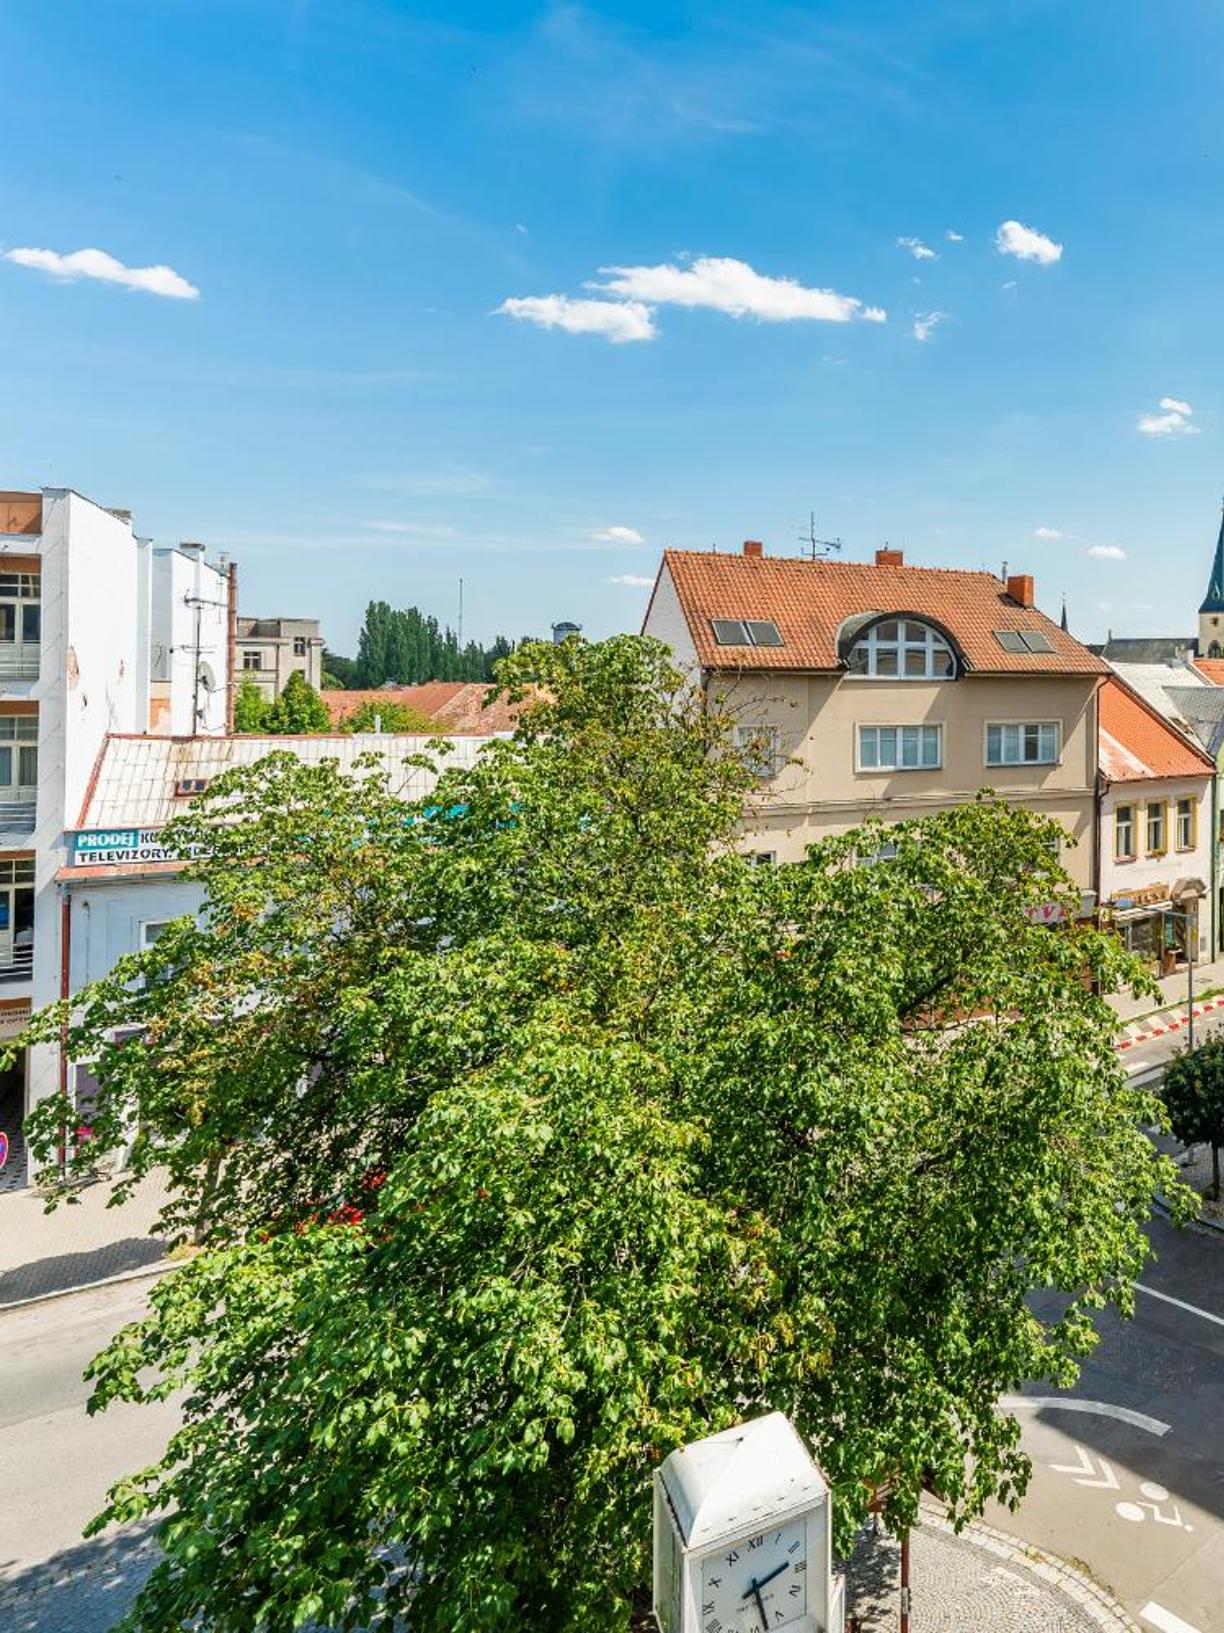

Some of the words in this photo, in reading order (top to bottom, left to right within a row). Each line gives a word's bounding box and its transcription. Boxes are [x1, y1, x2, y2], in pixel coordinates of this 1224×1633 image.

[78, 832, 134, 847] PRODEJ
[726, 1551, 739, 1567] XI
[708, 1579, 721, 1589] X
